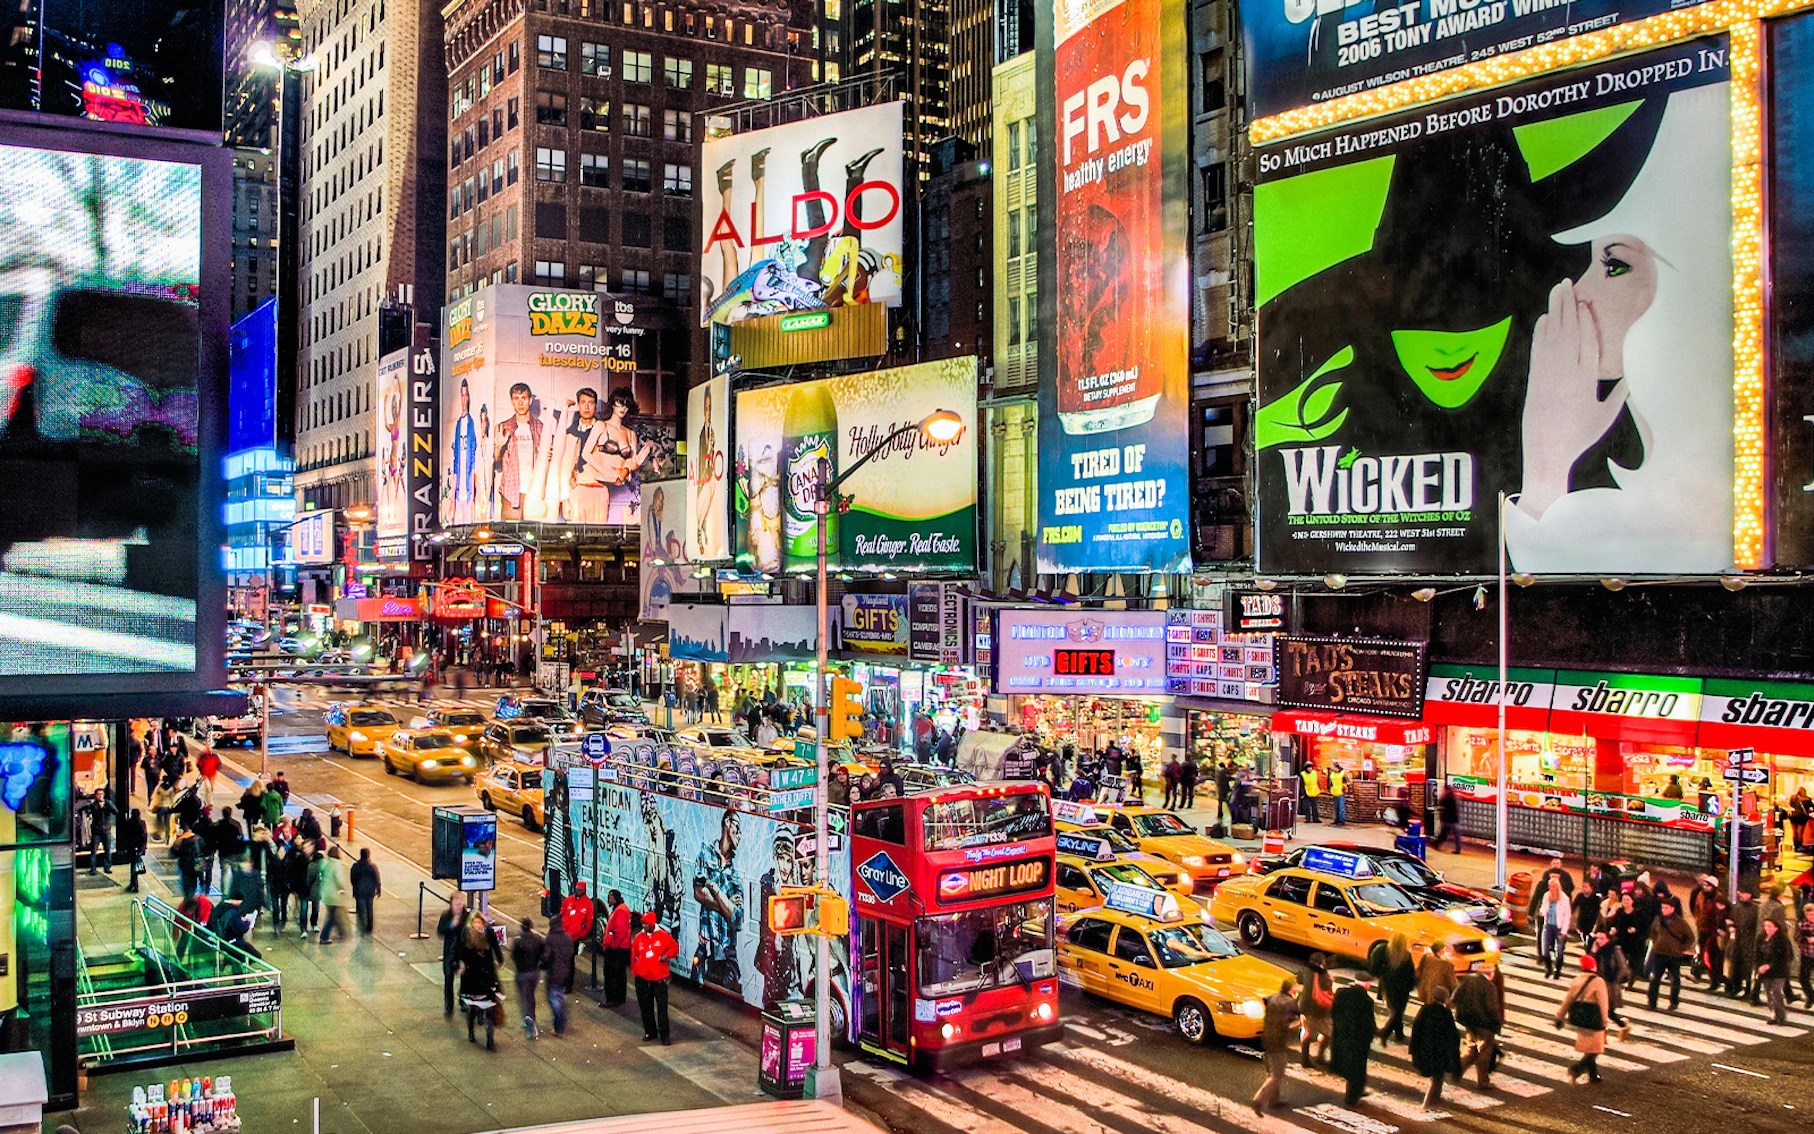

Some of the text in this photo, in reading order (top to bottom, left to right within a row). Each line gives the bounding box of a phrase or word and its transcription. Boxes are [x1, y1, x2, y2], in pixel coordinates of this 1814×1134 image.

[1337, 3, 1420, 46] BEST
[1337, 38, 1381, 67] 2006
[1384, 22, 1432, 53] TONY
[1435, 4, 1506, 40] AWARD
[1322, 81, 1365, 100] AUGUST
[1366, 69, 1410, 88] WILSON
[1412, 55, 1468, 76] THEATRE,
[1471, 46, 1495, 61] 245
[1499, 34, 1534, 52] WEST
[1568, 13, 1619, 36] STREET
[1064, 157, 1104, 193] healthy
[702, 180, 900, 254] ALDO
[528, 292, 634, 313] GLORY tbs
[529, 312, 598, 337] DAZE
[605, 326, 621, 336] very
[545, 341, 631, 357] november 16
[539, 353, 637, 373] tuesdays 10pm
[849, 424, 884, 462] Holly
[881, 421, 918, 459] Jolly
[414, 354, 433, 560] BRAZZERS
[1071, 444, 1146, 480] TIRED OF
[687, 450, 724, 486] ALDO
[1055, 478, 1166, 515] BEING TIRED?
[1042, 525, 1082, 544] FRS.COM
[1310, 529, 1347, 539] GERSHWIN
[1385, 529, 1398, 539] 222
[1400, 528, 1421, 539] WEST
[1436, 528, 1466, 537] STREET
[856, 534, 876, 556] Real
[910, 533, 932, 556] Real
[933, 532, 960, 552] Taste.
[917, 603, 938, 613] VIDEOS
[854, 608, 899, 632] GIFTS
[1193, 614, 1216, 623] T-SHIRTS
[1168, 629, 1190, 640] T-SHIRTS
[1171, 646, 1186, 657] CAPS
[1193, 648, 1216, 659] T-SHIRTS
[1246, 650, 1271, 662] T-SHIRTS
[1288, 642, 1354, 677] TAD'S
[1057, 651, 1112, 673] GIFTS
[1168, 664, 1190, 674] T-SHIRTS
[1196, 665, 1212, 674] CAPS
[1219, 666, 1243, 677] T-SHIRTS
[1193, 682, 1216, 693] T-SHIRTS
[1222, 684, 1239, 695] CAPS
[1329, 670, 1412, 702] STEAKS
[1441, 673, 1534, 706] sbarro
[1571, 681, 1679, 718] sbarro
[1295, 720, 1377, 740] TAD'S STEAKS
[1404, 726, 1430, 743] TAD'S
[1463, 734, 1487, 746] Pizza
[1505, 737, 1541, 753] esserts
[781, 768, 814, 786] W 47 ST
[598, 786, 631, 812] RICAN
[770, 789, 813, 806] FATHER DUFFY
[1452, 782, 1475, 792] sbarro
[1544, 787, 1579, 797] EATERY
[582, 805, 610, 830] EALE
[1680, 810, 1709, 822] sbarro
[582, 827, 632, 857] PRSENTS
[984, 832, 1008, 843] 71336
[1057, 837, 1099, 853] SKYLINE
[861, 865, 906, 888] Gray Line
[969, 862, 1043, 892] NIGHT LOOP
[1116, 972, 1154, 990] NYC TAXI
[84, 1002, 189, 1023] St Subway Station
[114, 1021, 121, 1029] &
[122, 1017, 145, 1029] Bklyn
